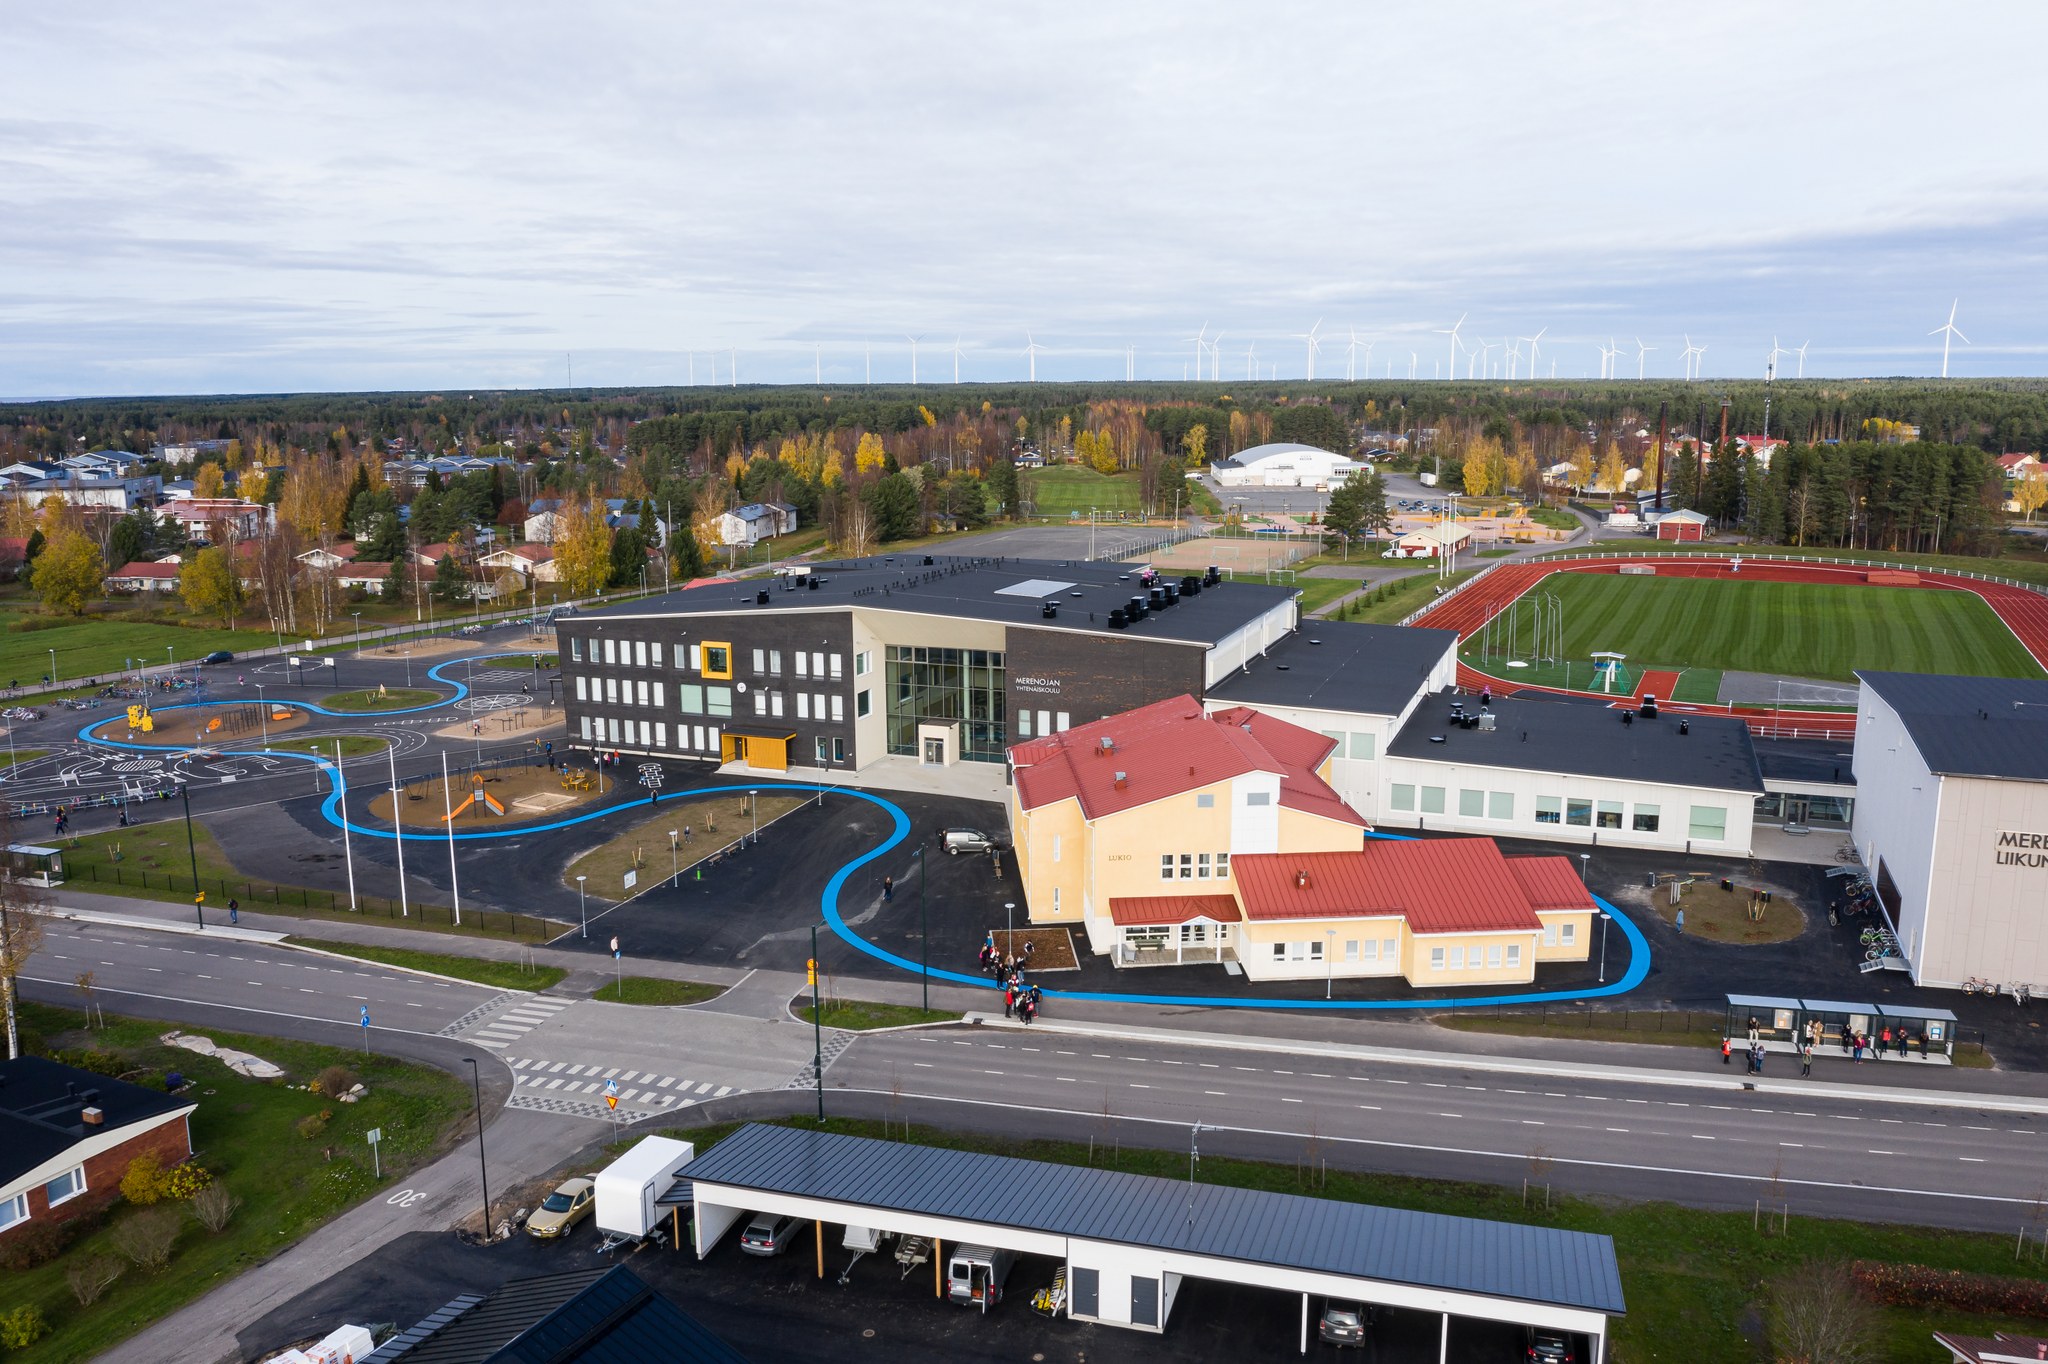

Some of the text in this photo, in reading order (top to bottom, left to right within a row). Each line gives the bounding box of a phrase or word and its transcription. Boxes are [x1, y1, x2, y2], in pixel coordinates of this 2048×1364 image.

[1015, 677, 1061, 687] MERENOJAN
[1015, 685, 1061, 694] YHTENÄISKOULU
[1108, 854, 1132, 862] LUKIO
[386, 1189, 427, 1208] 30
